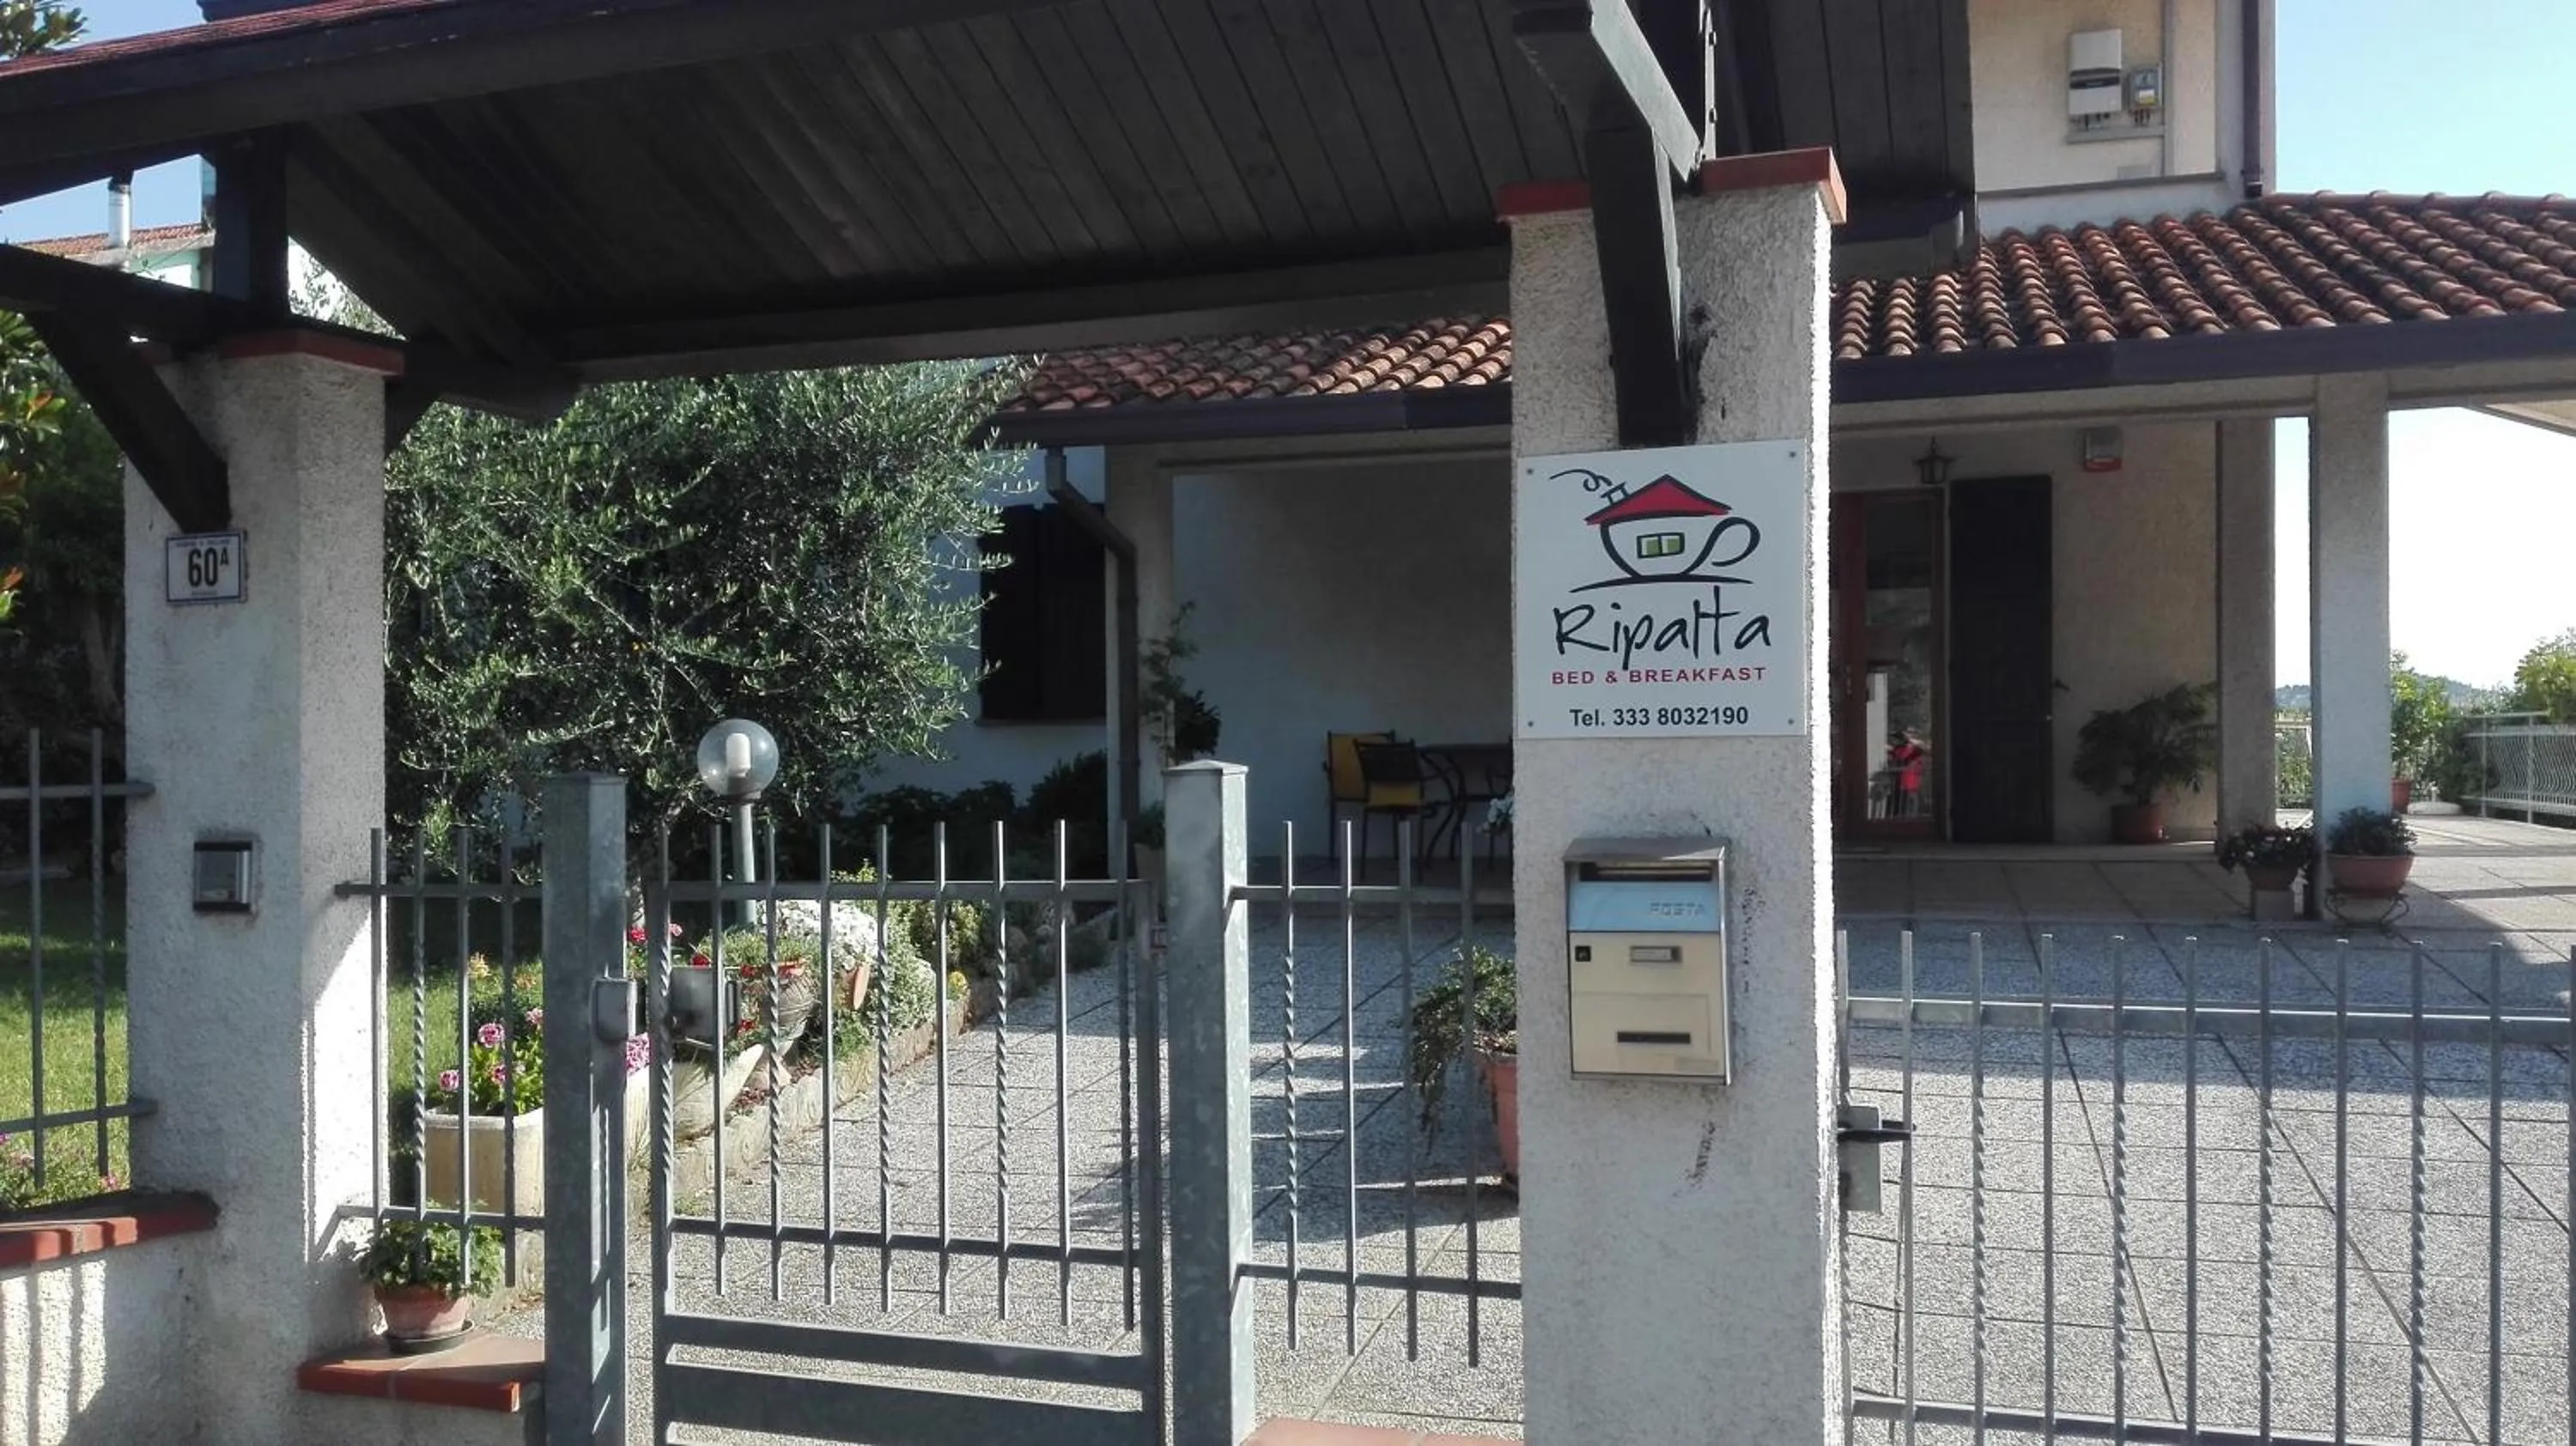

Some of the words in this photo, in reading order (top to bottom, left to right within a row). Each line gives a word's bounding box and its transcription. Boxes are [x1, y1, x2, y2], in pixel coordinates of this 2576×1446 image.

[1552, 586, 1771, 671] Ripalta
[1552, 671, 1595, 685] BED
[1605, 671, 1618, 684] &
[1629, 667, 1766, 684] BREAKFAST
[1570, 708, 1605, 726] Tel.
[1613, 708, 1649, 726] 333
[1657, 707, 1749, 726] 8032190
[1649, 902, 1706, 917] POSTA
